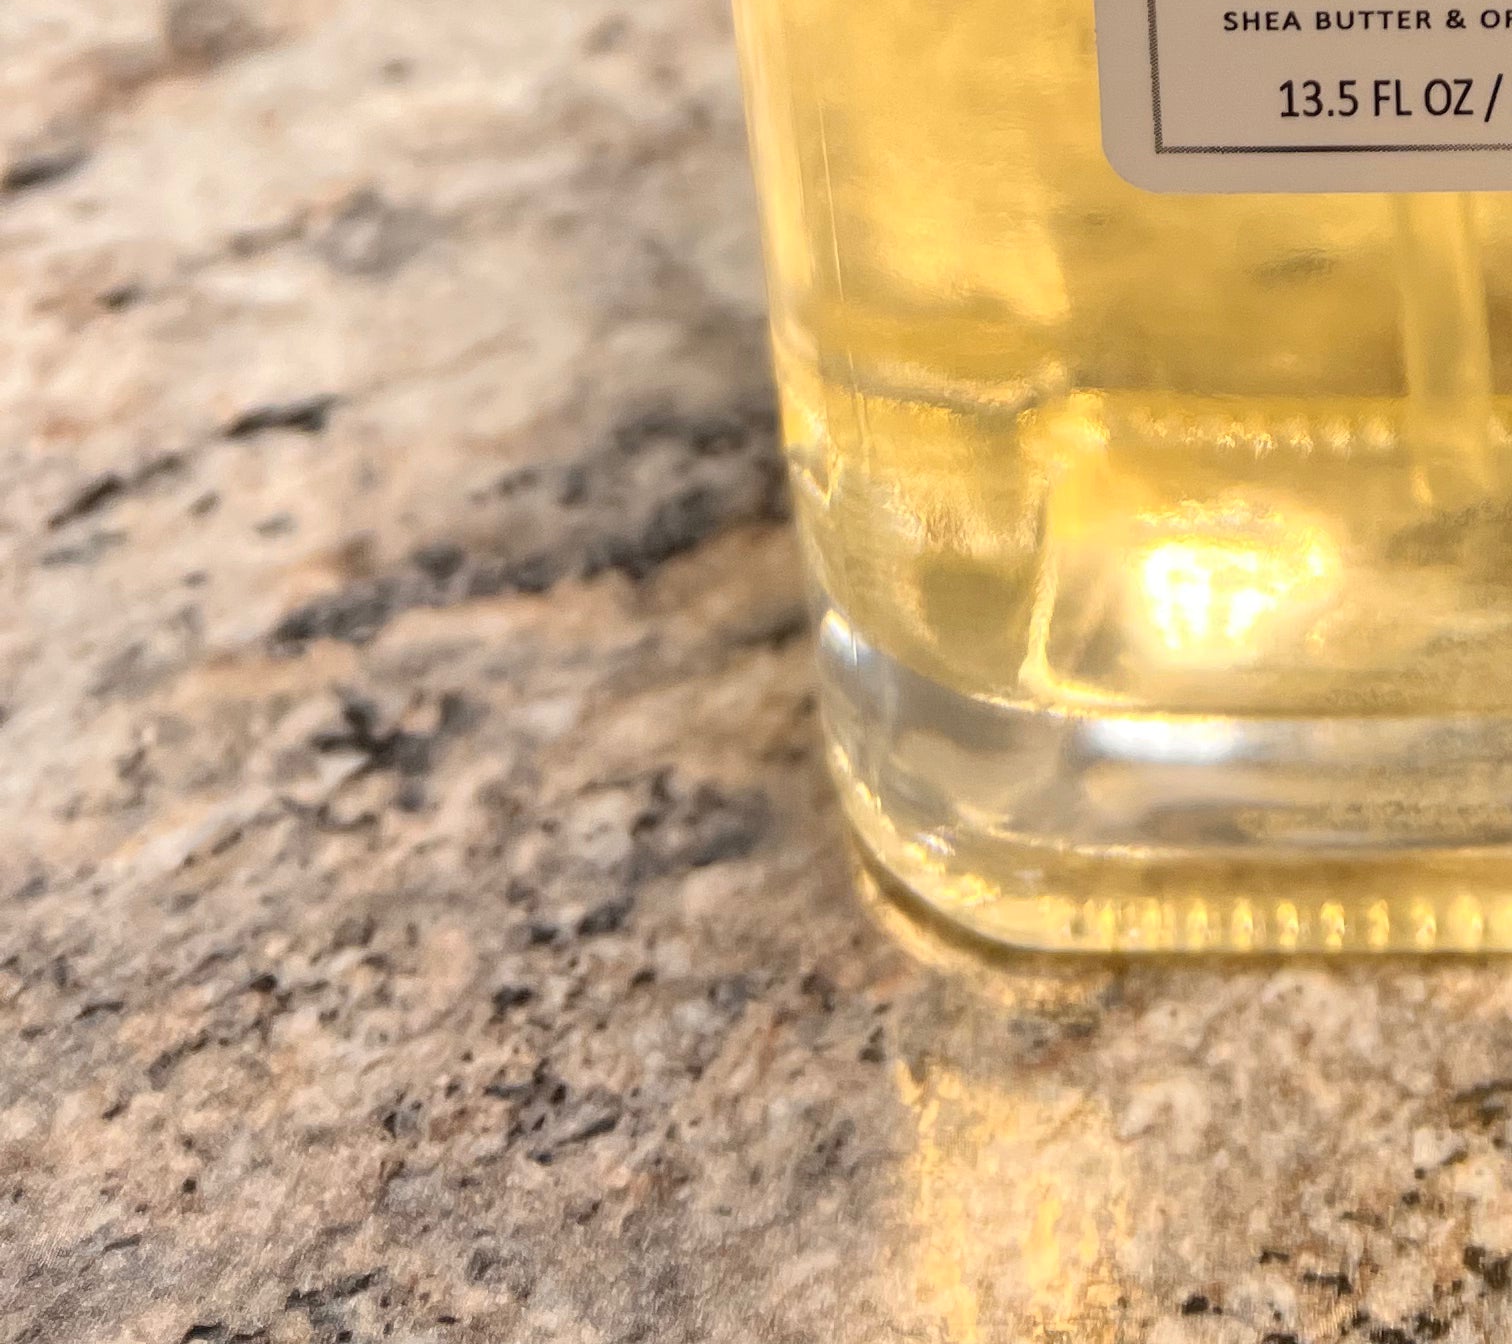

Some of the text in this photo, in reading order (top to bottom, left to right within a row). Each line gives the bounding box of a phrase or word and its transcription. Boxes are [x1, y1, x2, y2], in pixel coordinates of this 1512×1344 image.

[1223, 11, 1302, 32] SHEA
[1315, 10, 1432, 31] BUTTER
[1445, 9, 1467, 30] &
[1279, 79, 1359, 118] 13.5
[1373, 79, 1413, 117] FL
[1423, 78, 1474, 116] OZ
